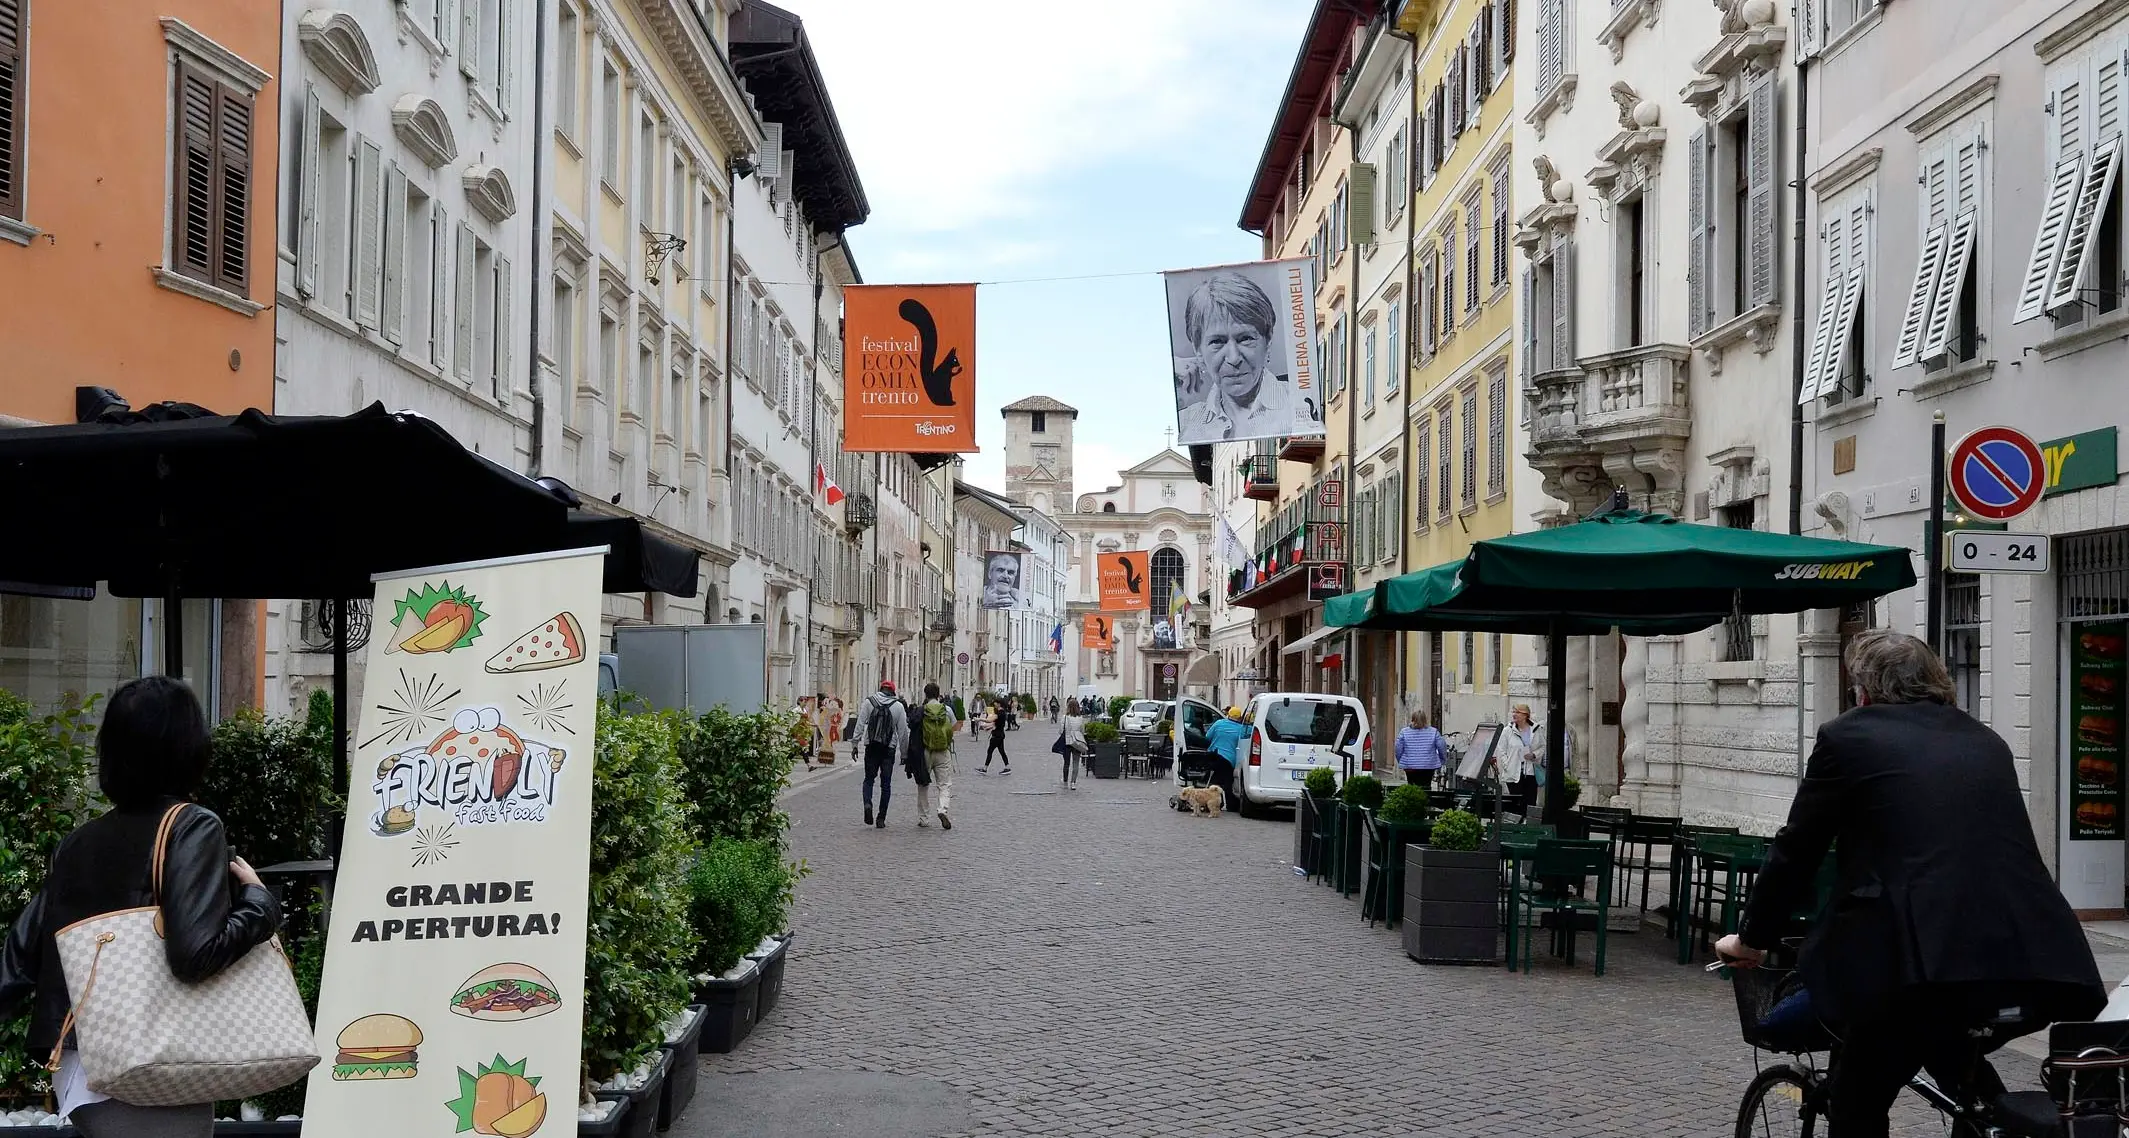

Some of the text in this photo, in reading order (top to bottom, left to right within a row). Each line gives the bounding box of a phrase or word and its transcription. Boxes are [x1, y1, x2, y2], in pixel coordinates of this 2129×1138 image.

[1289, 268, 1311, 389] MILENA GABANELLI
[861, 335, 919, 352] festival
[862, 353, 918, 370] ECON
[862, 371, 917, 389] OMIA
[861, 391, 919, 404] trento
[915, 421, 955, 435] TRENTINO
[1963, 542, 1978, 560] 0
[2007, 544, 2037, 561] 24
[1774, 560, 1875, 580] SUBWAY
[386, 880, 534, 908] GRANDE
[351, 912, 562, 943] APERTURA!
